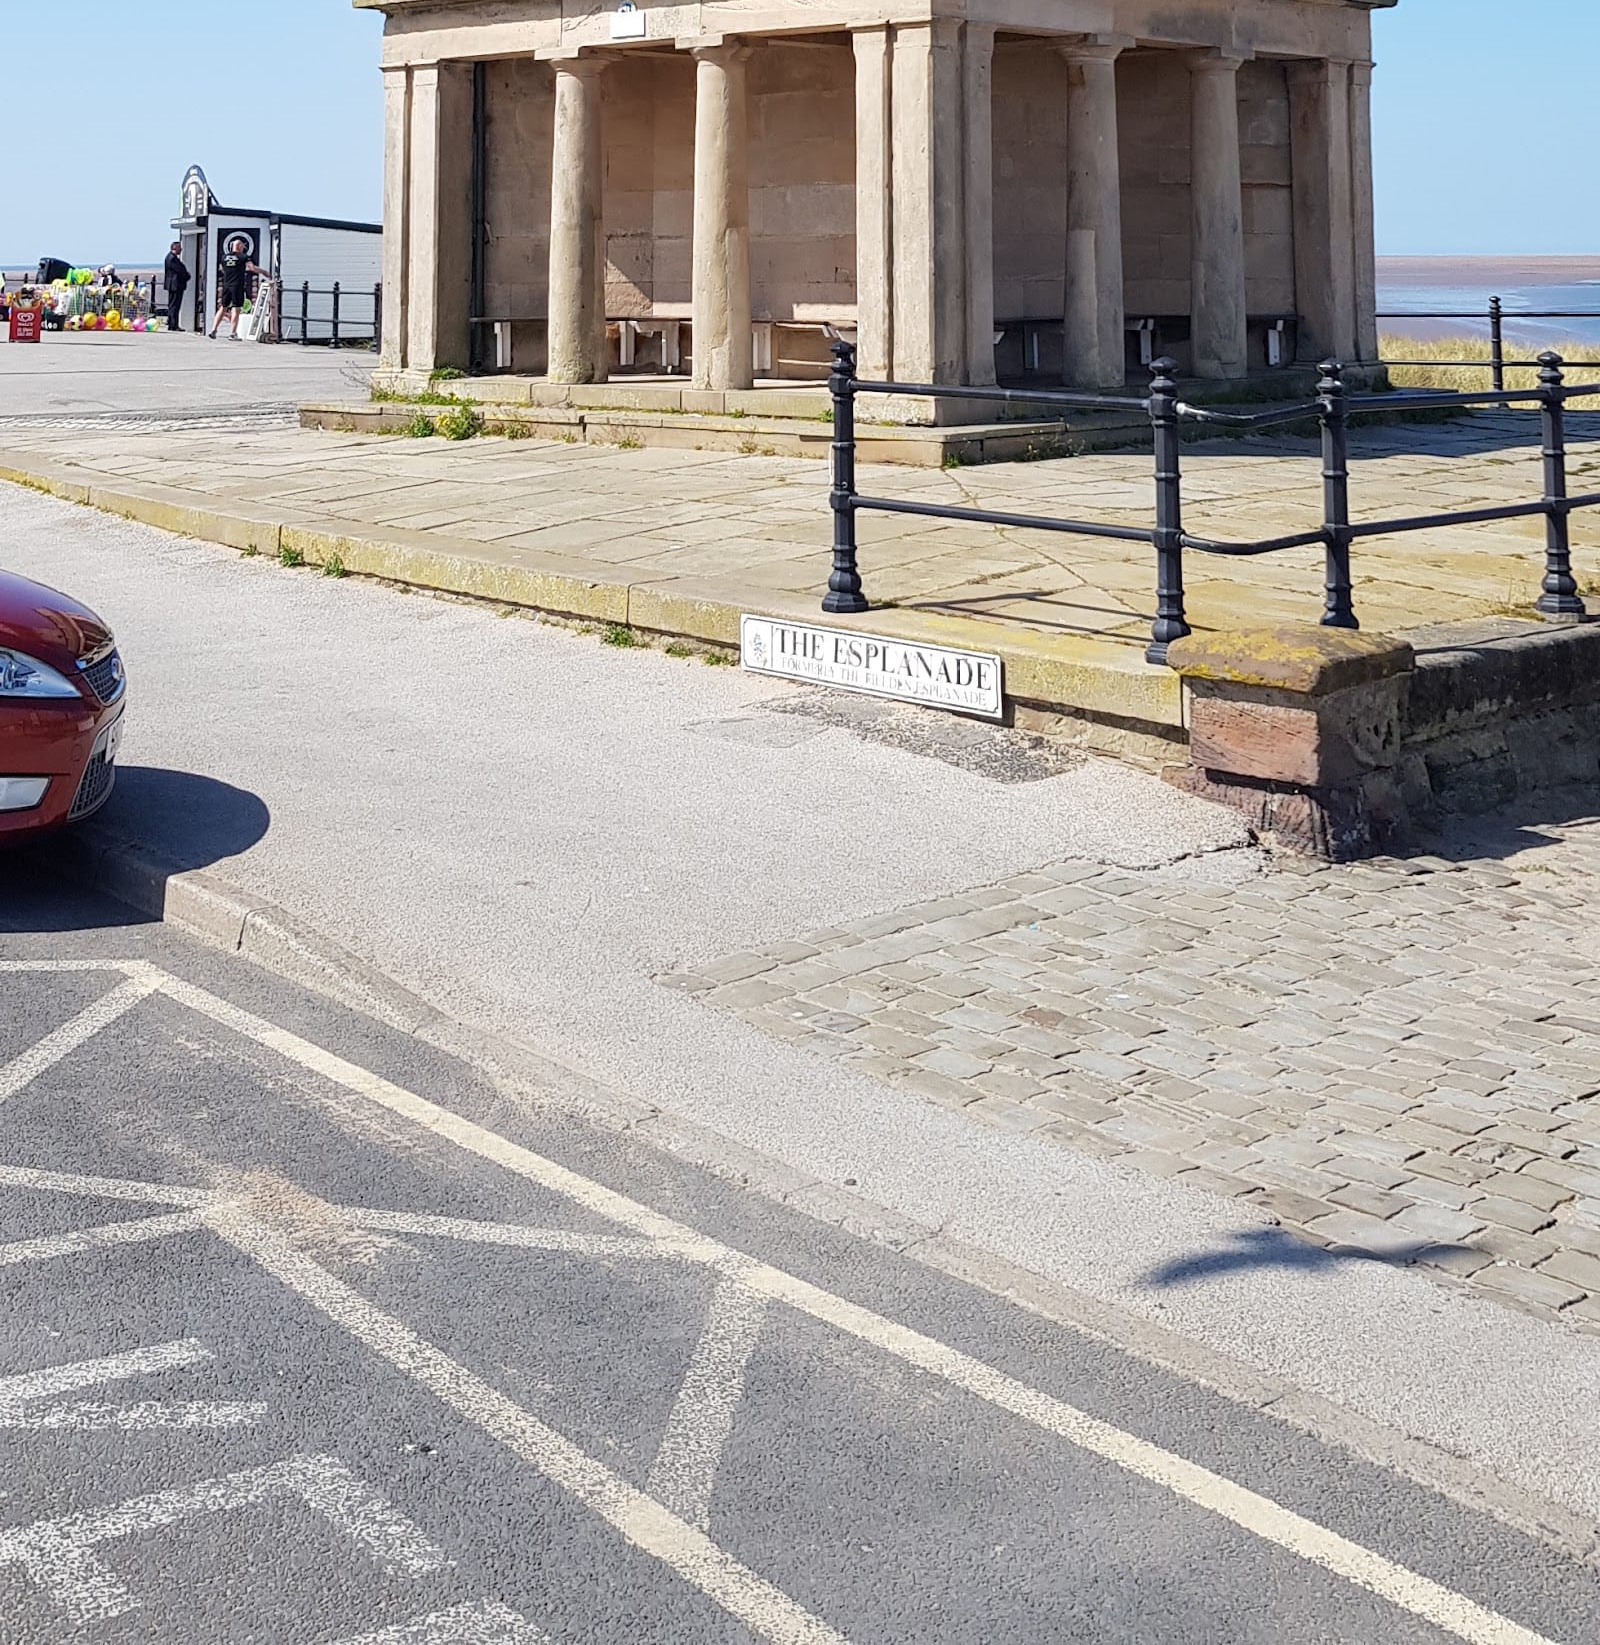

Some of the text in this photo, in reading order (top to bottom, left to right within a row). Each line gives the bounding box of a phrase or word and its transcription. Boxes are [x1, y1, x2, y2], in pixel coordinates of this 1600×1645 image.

[776, 628, 991, 690] THE ESPLANADE
[782, 657, 835, 679] FORMERLY
[914, 680, 987, 706] ESPLANADE
